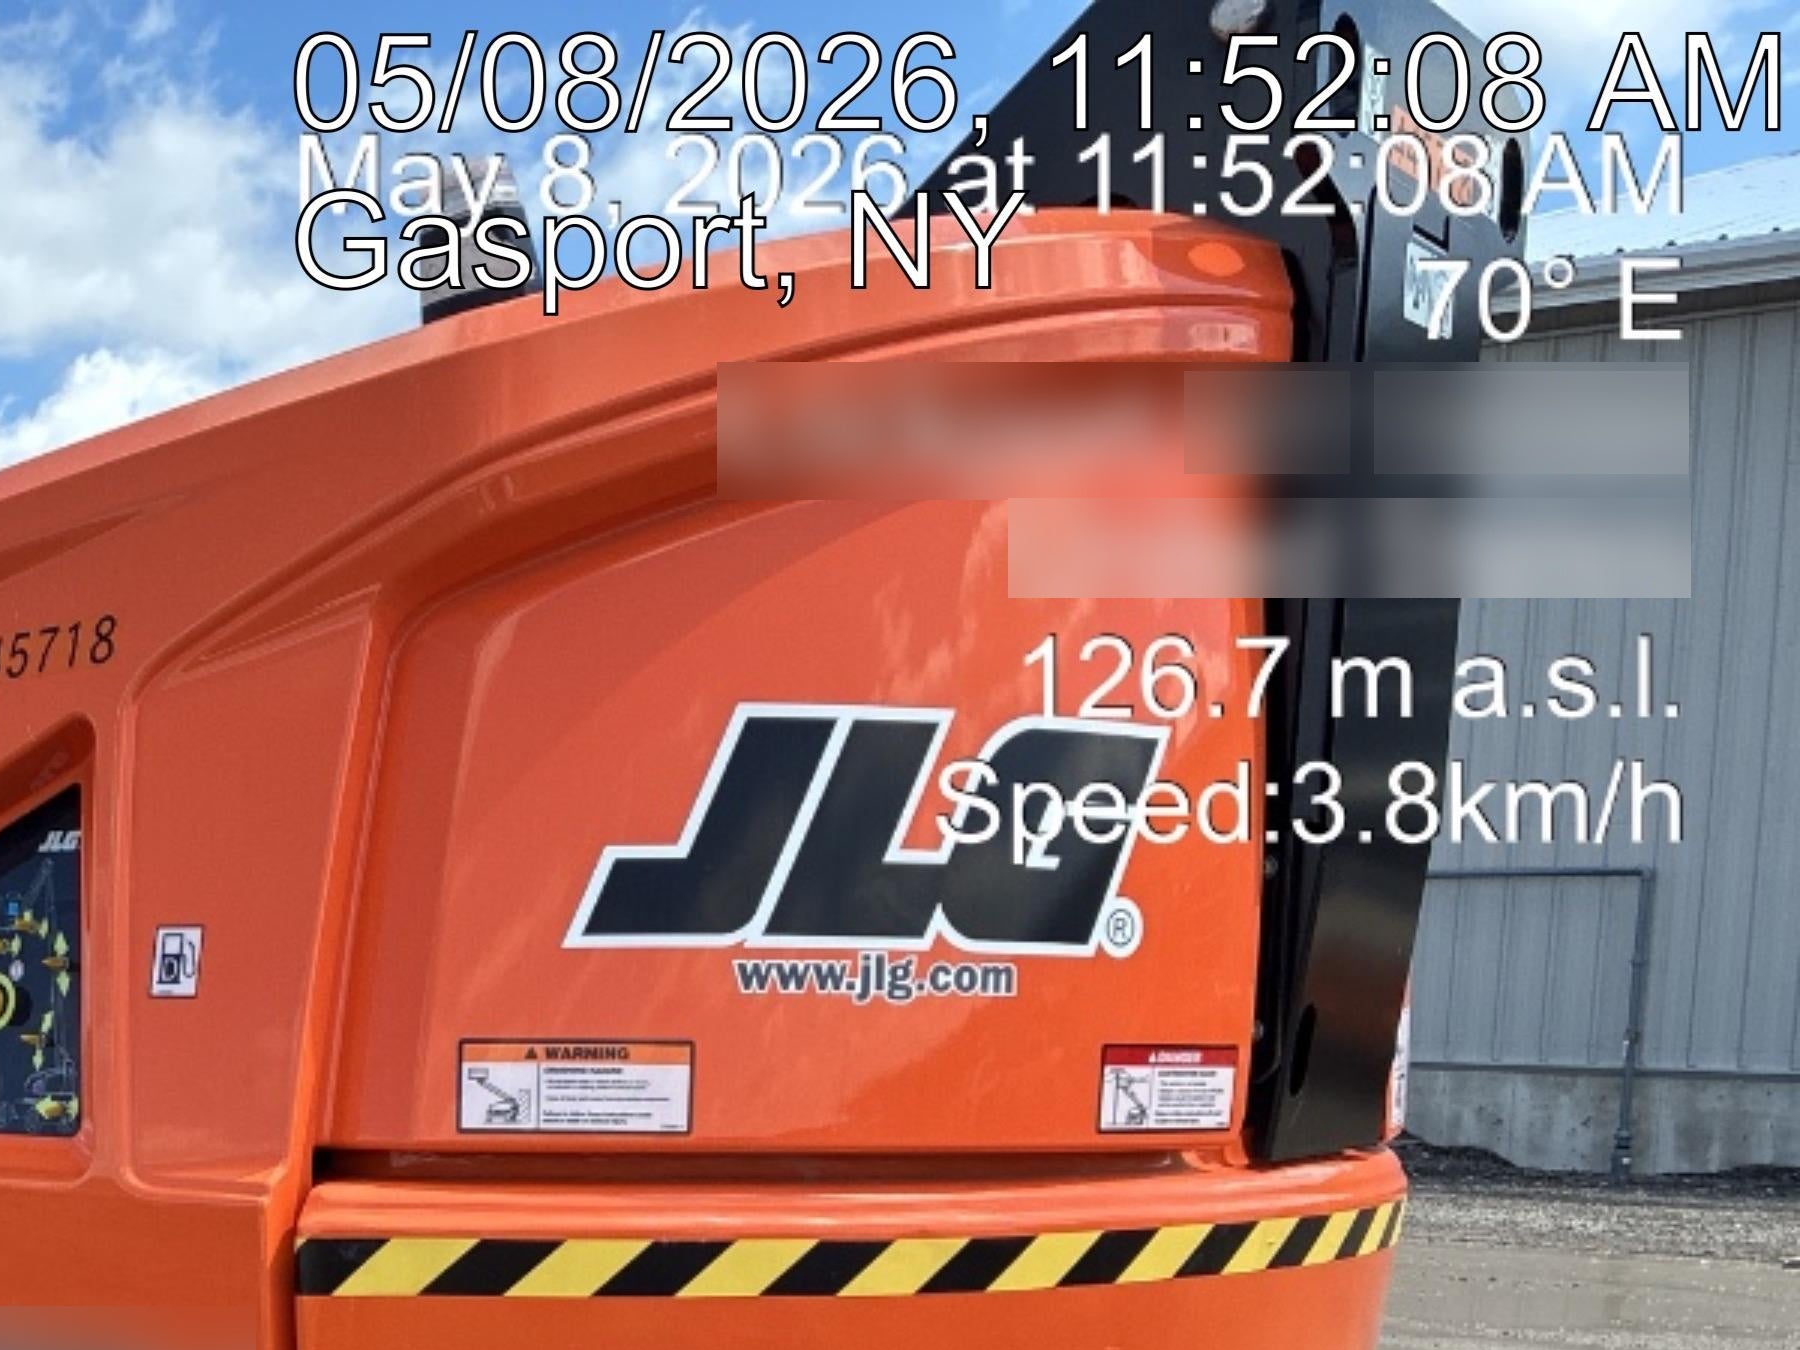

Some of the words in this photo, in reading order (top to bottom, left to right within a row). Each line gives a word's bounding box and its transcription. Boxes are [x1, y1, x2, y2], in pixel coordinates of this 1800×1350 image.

[561, 702, 1172, 957] JLG
[732, 951, 1017, 1003] www.jlg.com
[544, 1045, 631, 1061] WARNING
